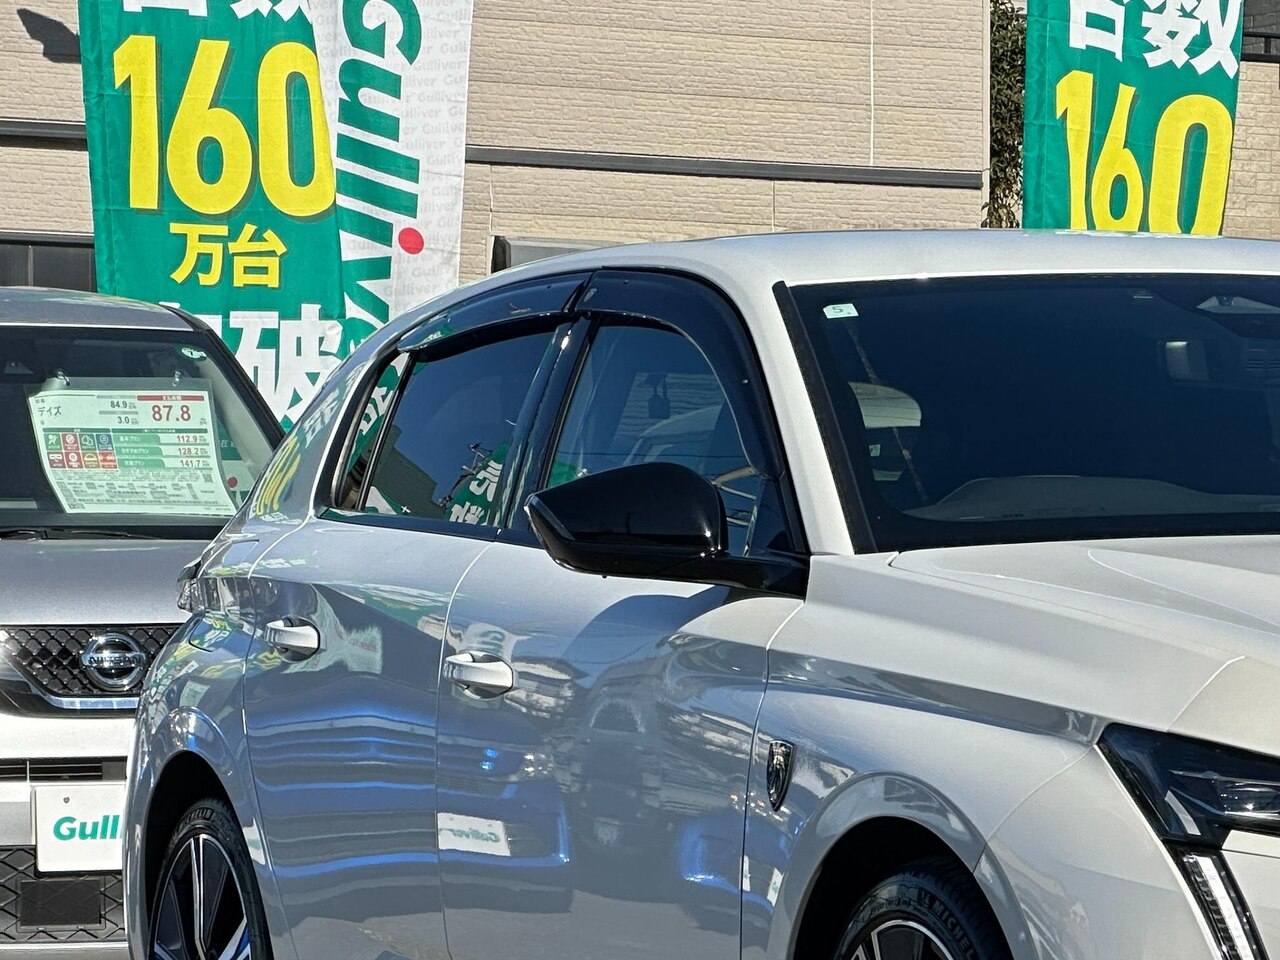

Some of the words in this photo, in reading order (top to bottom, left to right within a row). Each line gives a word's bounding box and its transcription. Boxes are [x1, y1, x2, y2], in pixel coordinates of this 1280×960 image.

[113, 35, 337, 217] 160
[1055, 69, 1233, 236] 160
[167, 222, 288, 288] 万台
[110, 400, 128, 409] 84.9
[37, 405, 62, 417] デイズ
[152, 404, 191, 422] 87.8
[117, 416, 130, 425] 3.0
[176, 435, 198, 443] 112.9
[178, 447, 199, 456] 128.2
[180, 459, 201, 468] 141.7
[89, 655, 142, 665] NISSAN
[53, 814, 122, 841] Gull
